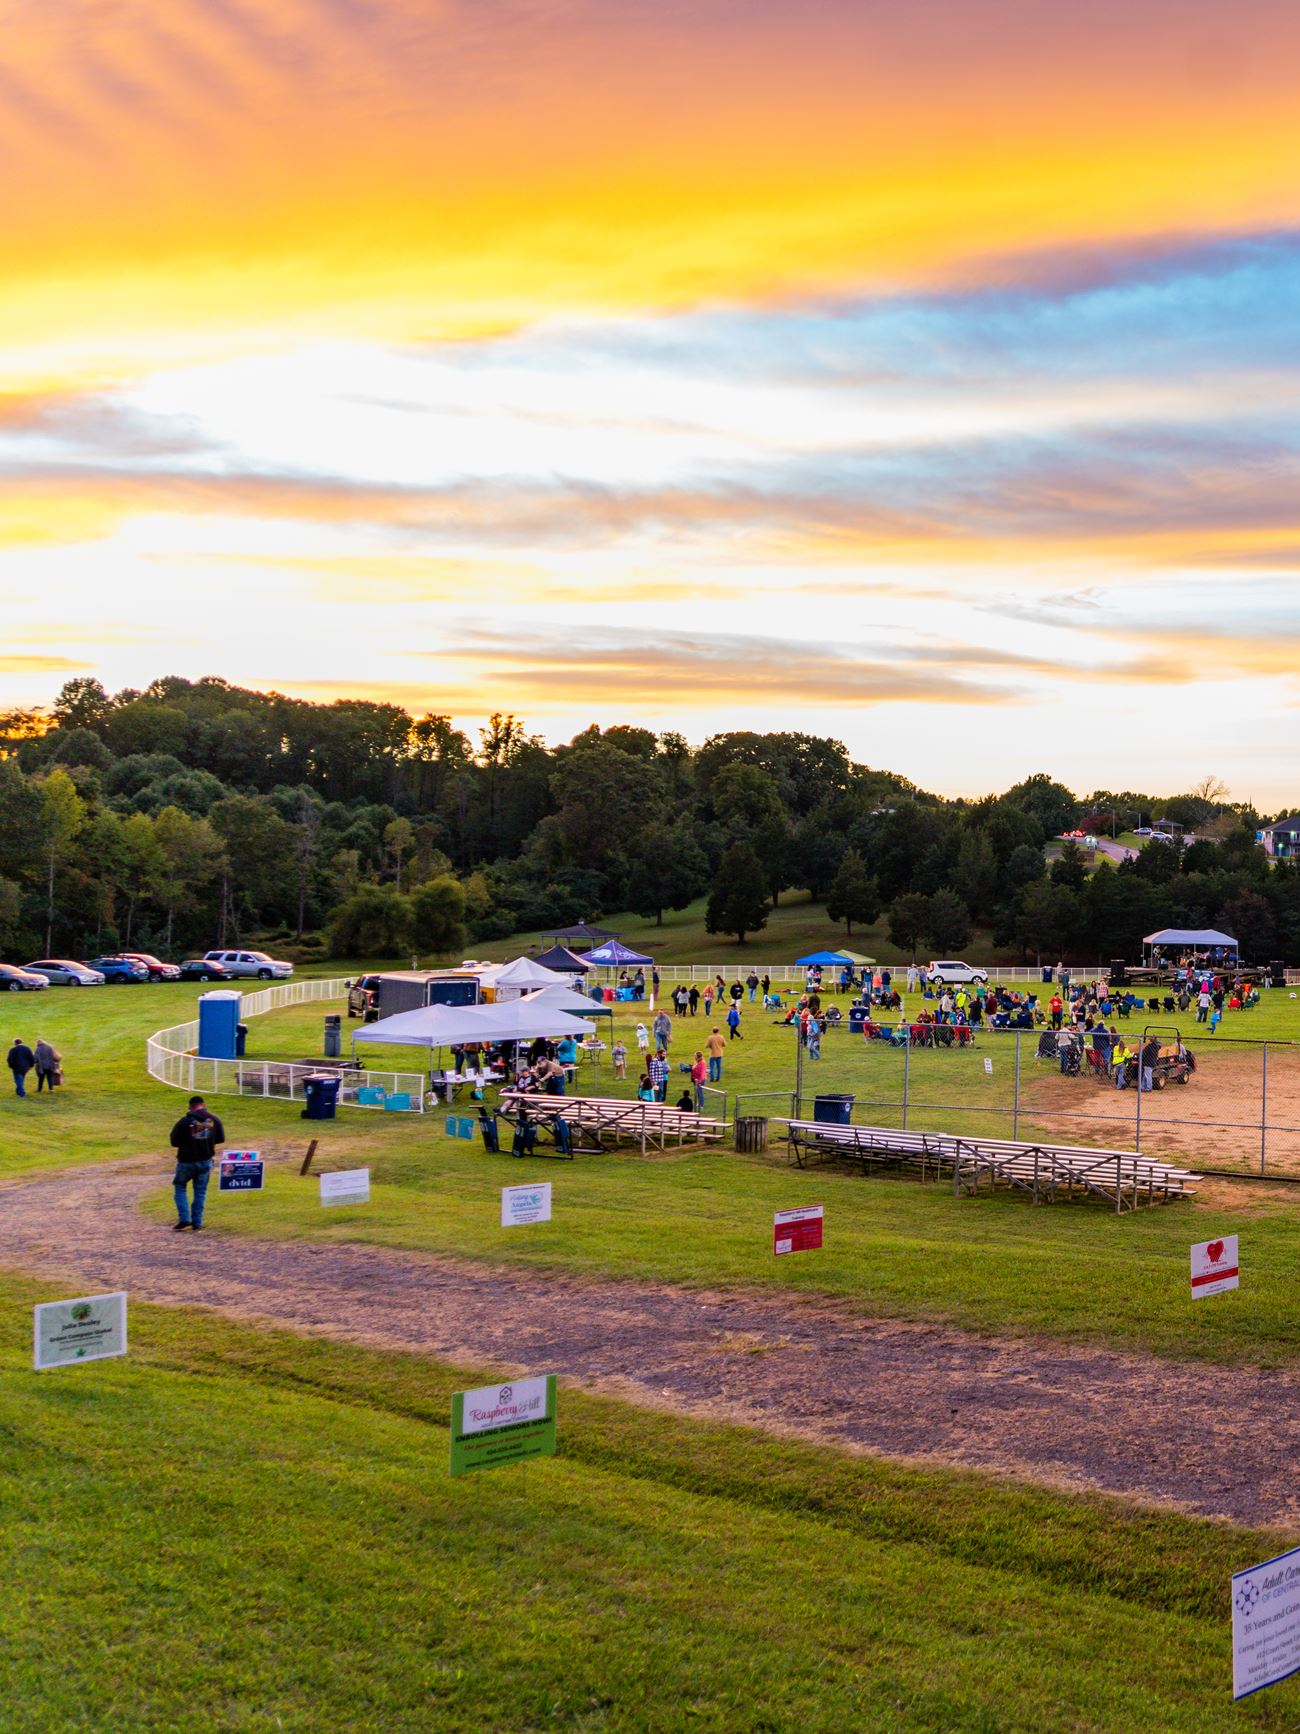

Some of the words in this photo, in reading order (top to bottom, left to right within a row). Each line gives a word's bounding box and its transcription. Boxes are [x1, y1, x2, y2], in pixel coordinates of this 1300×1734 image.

[470, 1403, 517, 1421] Raspberry
[456, 1429, 498, 1442] ENROLLING
[500, 1422, 530, 1432] SENIORS
[1262, 1572, 1283, 1590] Adult
[1262, 1592, 1270, 1603] OF
[1273, 1581, 1300, 1598] CENTRAL
[1254, 1618, 1271, 1629] Years
[1273, 1609, 1284, 1621] and
